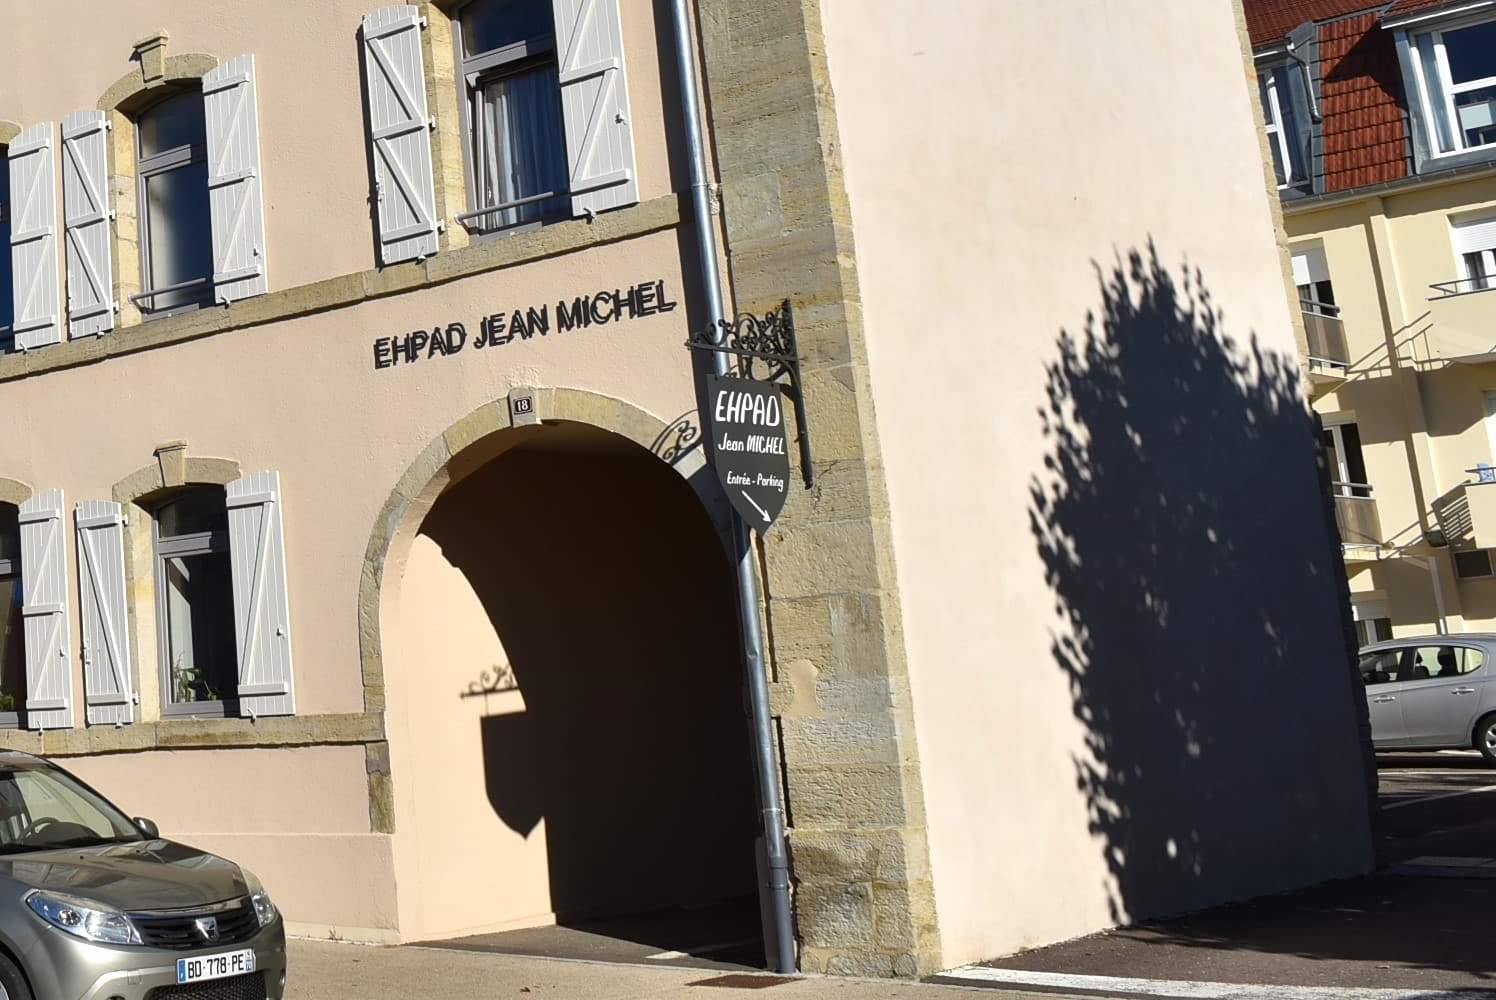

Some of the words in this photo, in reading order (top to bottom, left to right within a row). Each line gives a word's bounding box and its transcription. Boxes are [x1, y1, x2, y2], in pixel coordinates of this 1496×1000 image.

[373, 323, 467, 370] EHPAD
[473, 303, 550, 349] JEAN
[557, 280, 677, 333] MICHEL
[517, 400, 529, 411] 18
[715, 390, 780, 426] EHPAD
[718, 432, 744, 451] Jean
[746, 434, 785, 455] MICHEL
[727, 470, 751, 486] Entrée
[756, 472, 784, 492] Parking
